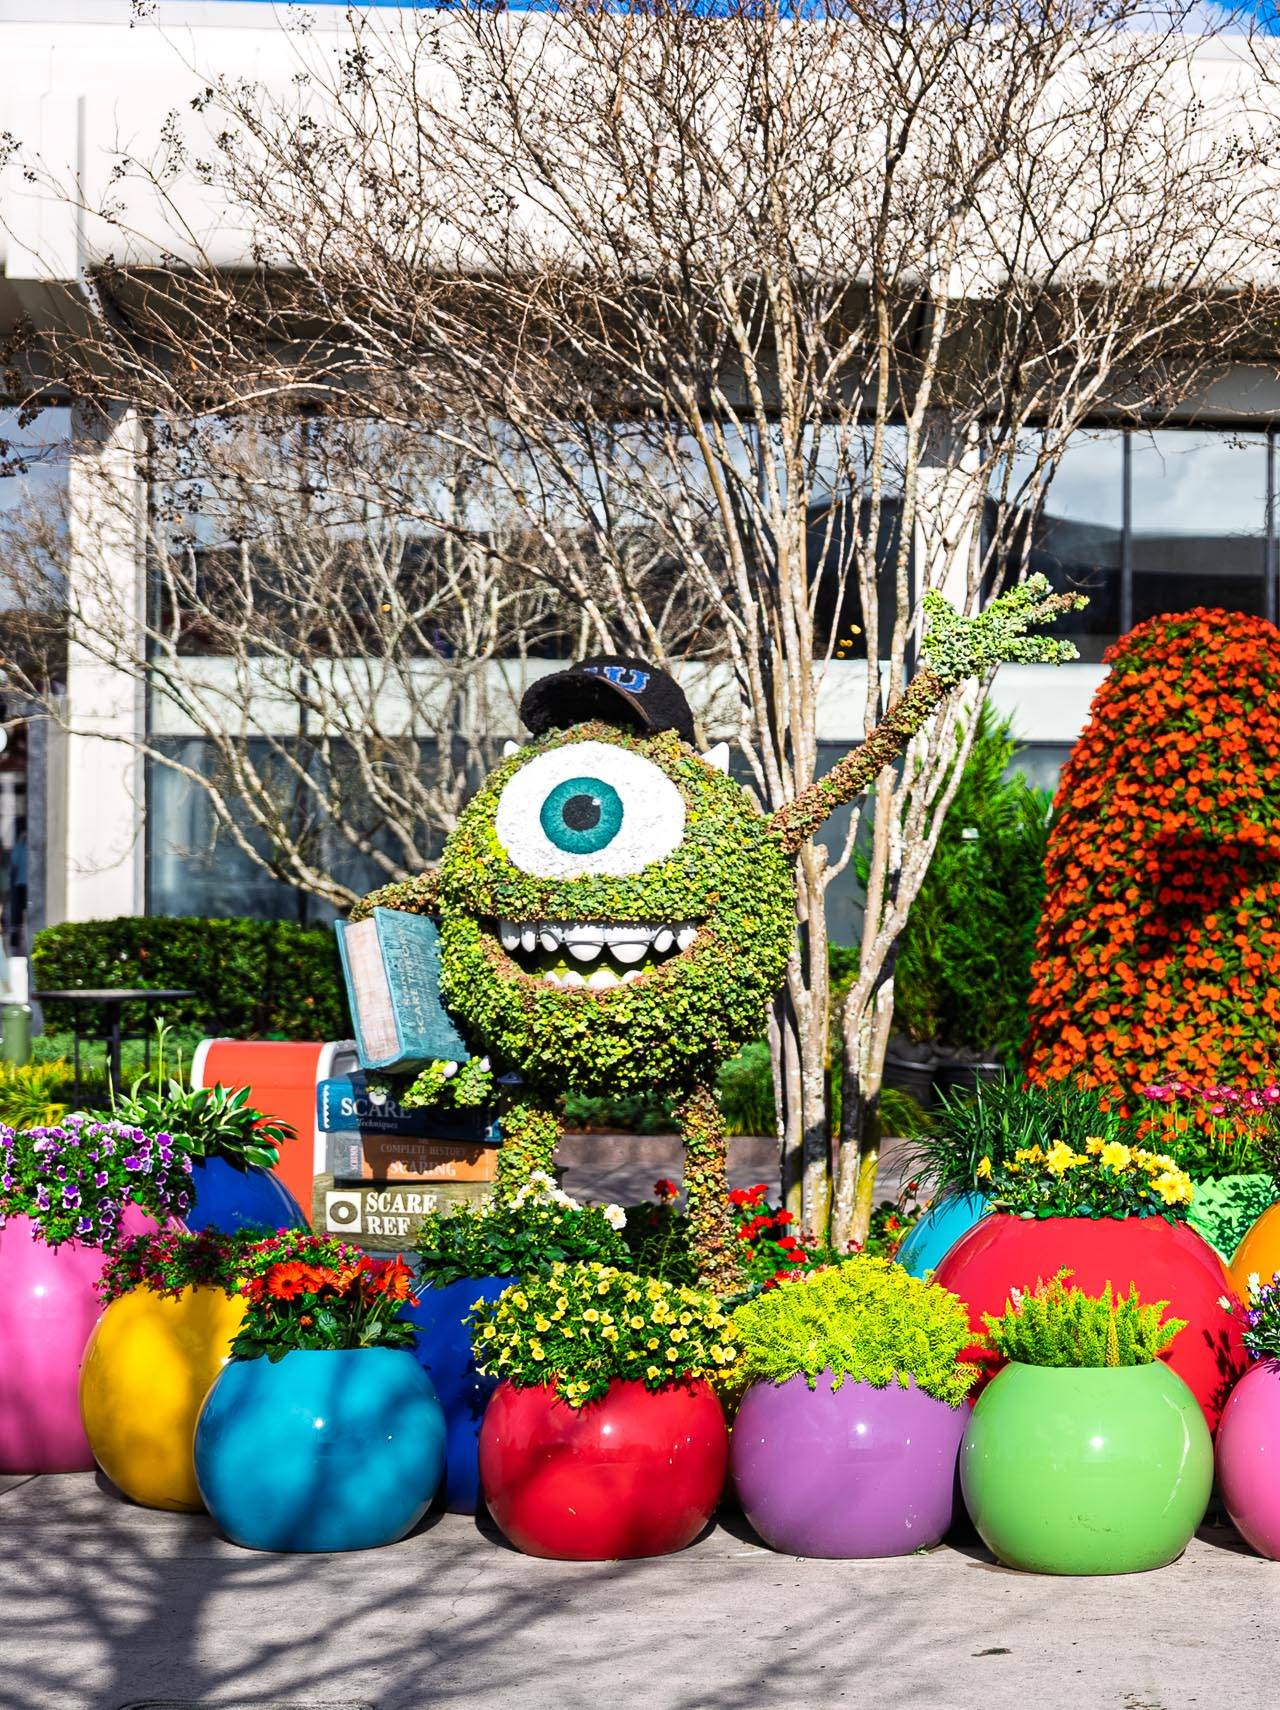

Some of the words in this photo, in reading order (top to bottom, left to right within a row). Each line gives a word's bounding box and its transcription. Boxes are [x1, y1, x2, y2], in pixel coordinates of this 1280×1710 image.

[341, 1097, 412, 1119] SCARE
[356, 1118, 398, 1131] Techniques
[380, 1143, 426, 1155] COMPLETE
[365, 1191, 438, 1215] SCARE
[366, 1215, 411, 1236] REF
